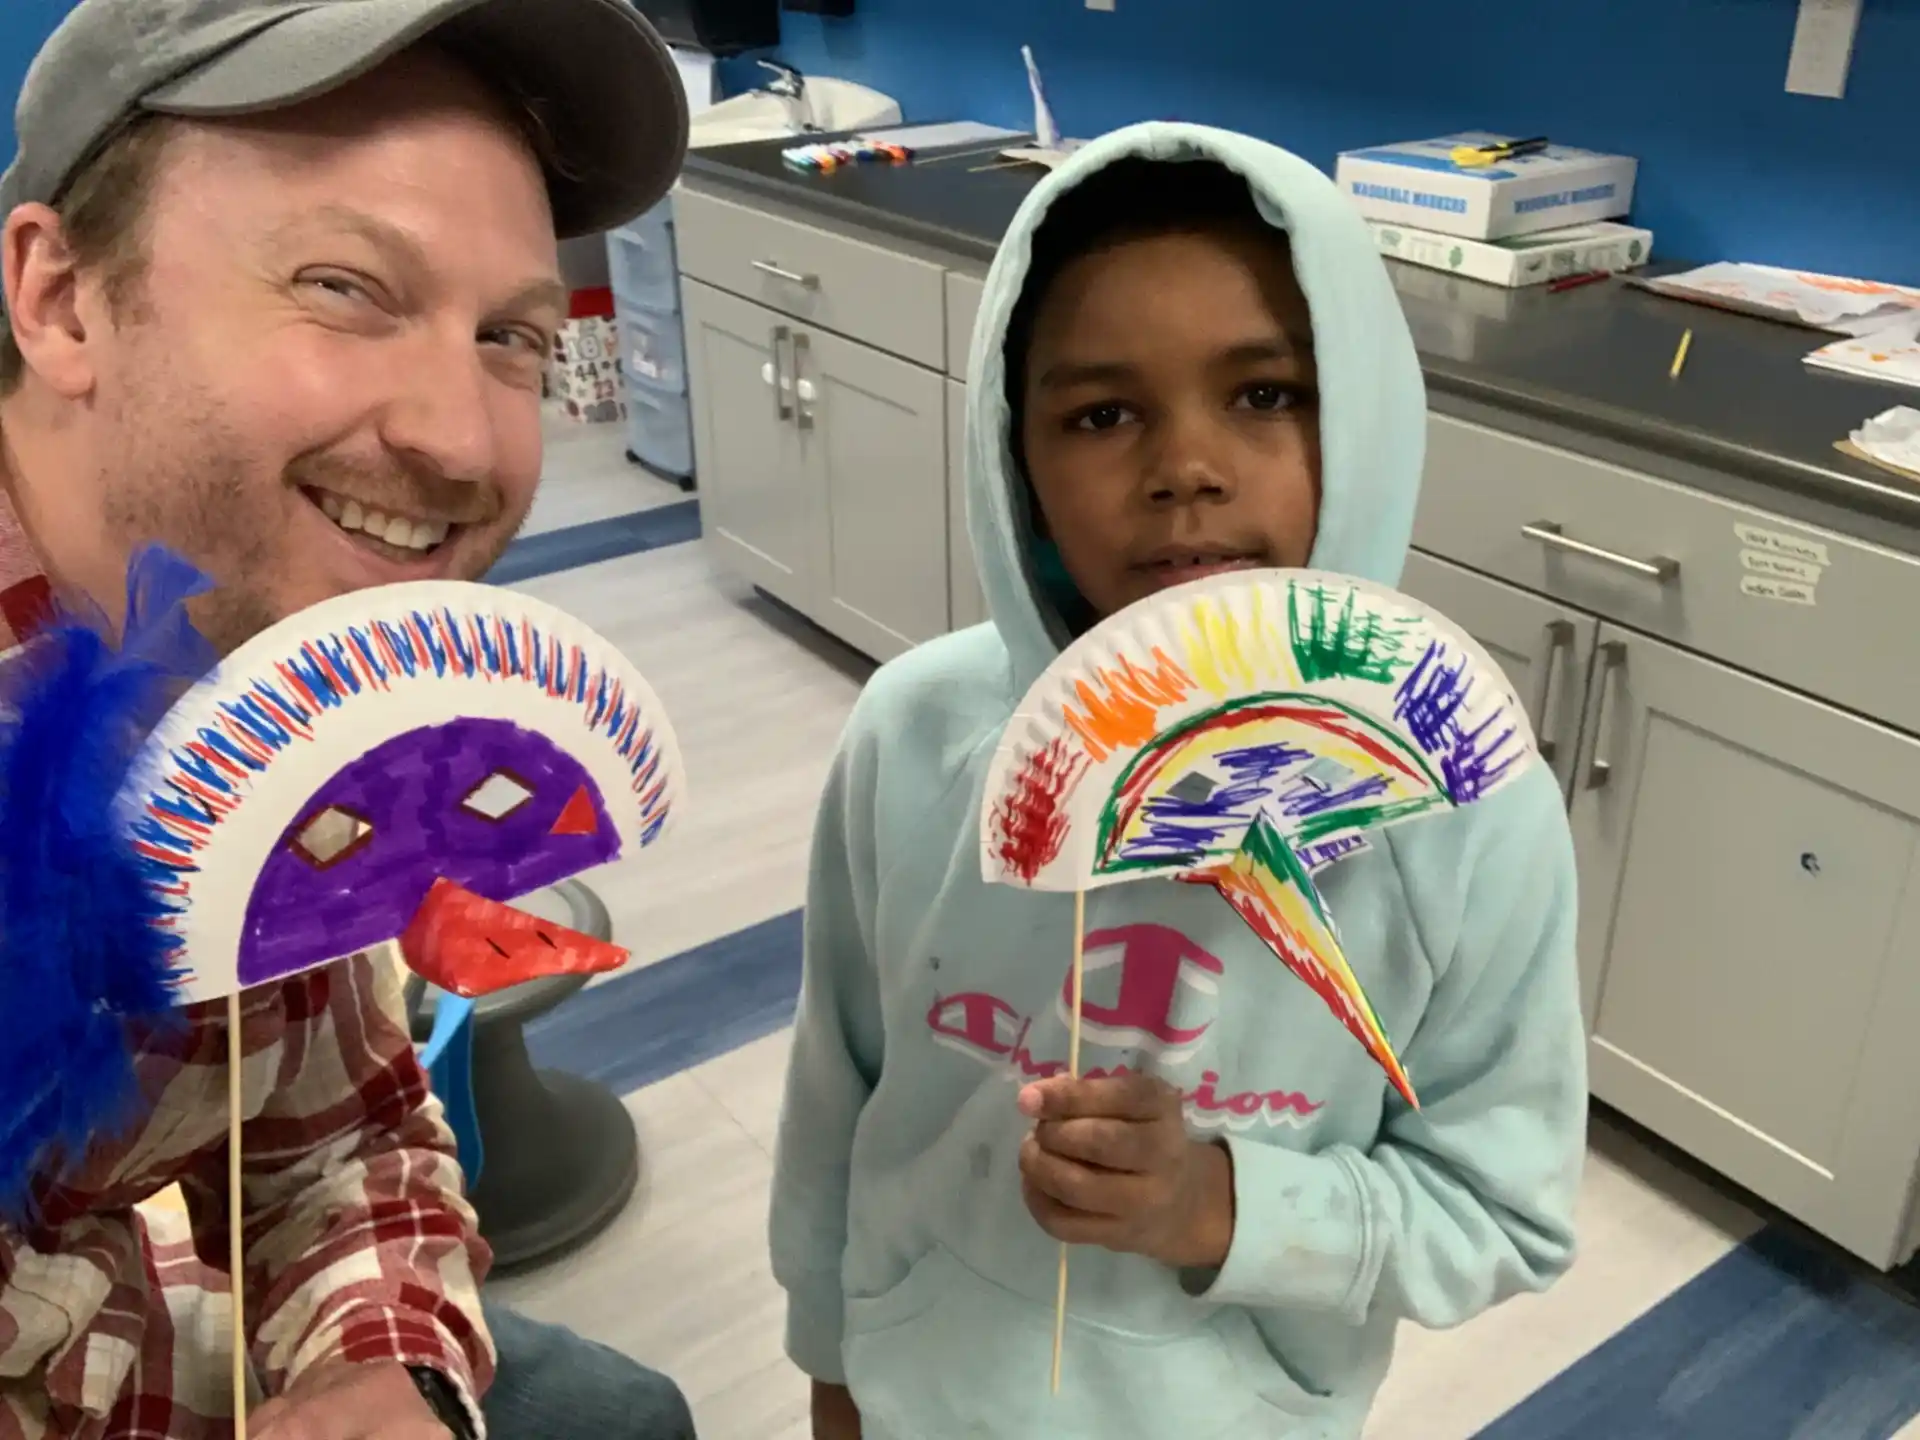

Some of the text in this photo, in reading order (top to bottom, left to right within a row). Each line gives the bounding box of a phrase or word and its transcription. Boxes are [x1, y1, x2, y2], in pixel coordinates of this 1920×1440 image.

[1413, 192, 1468, 214] MARKERS
[575, 363, 599, 383] 44
[926, 991, 1327, 1117] Chaion
